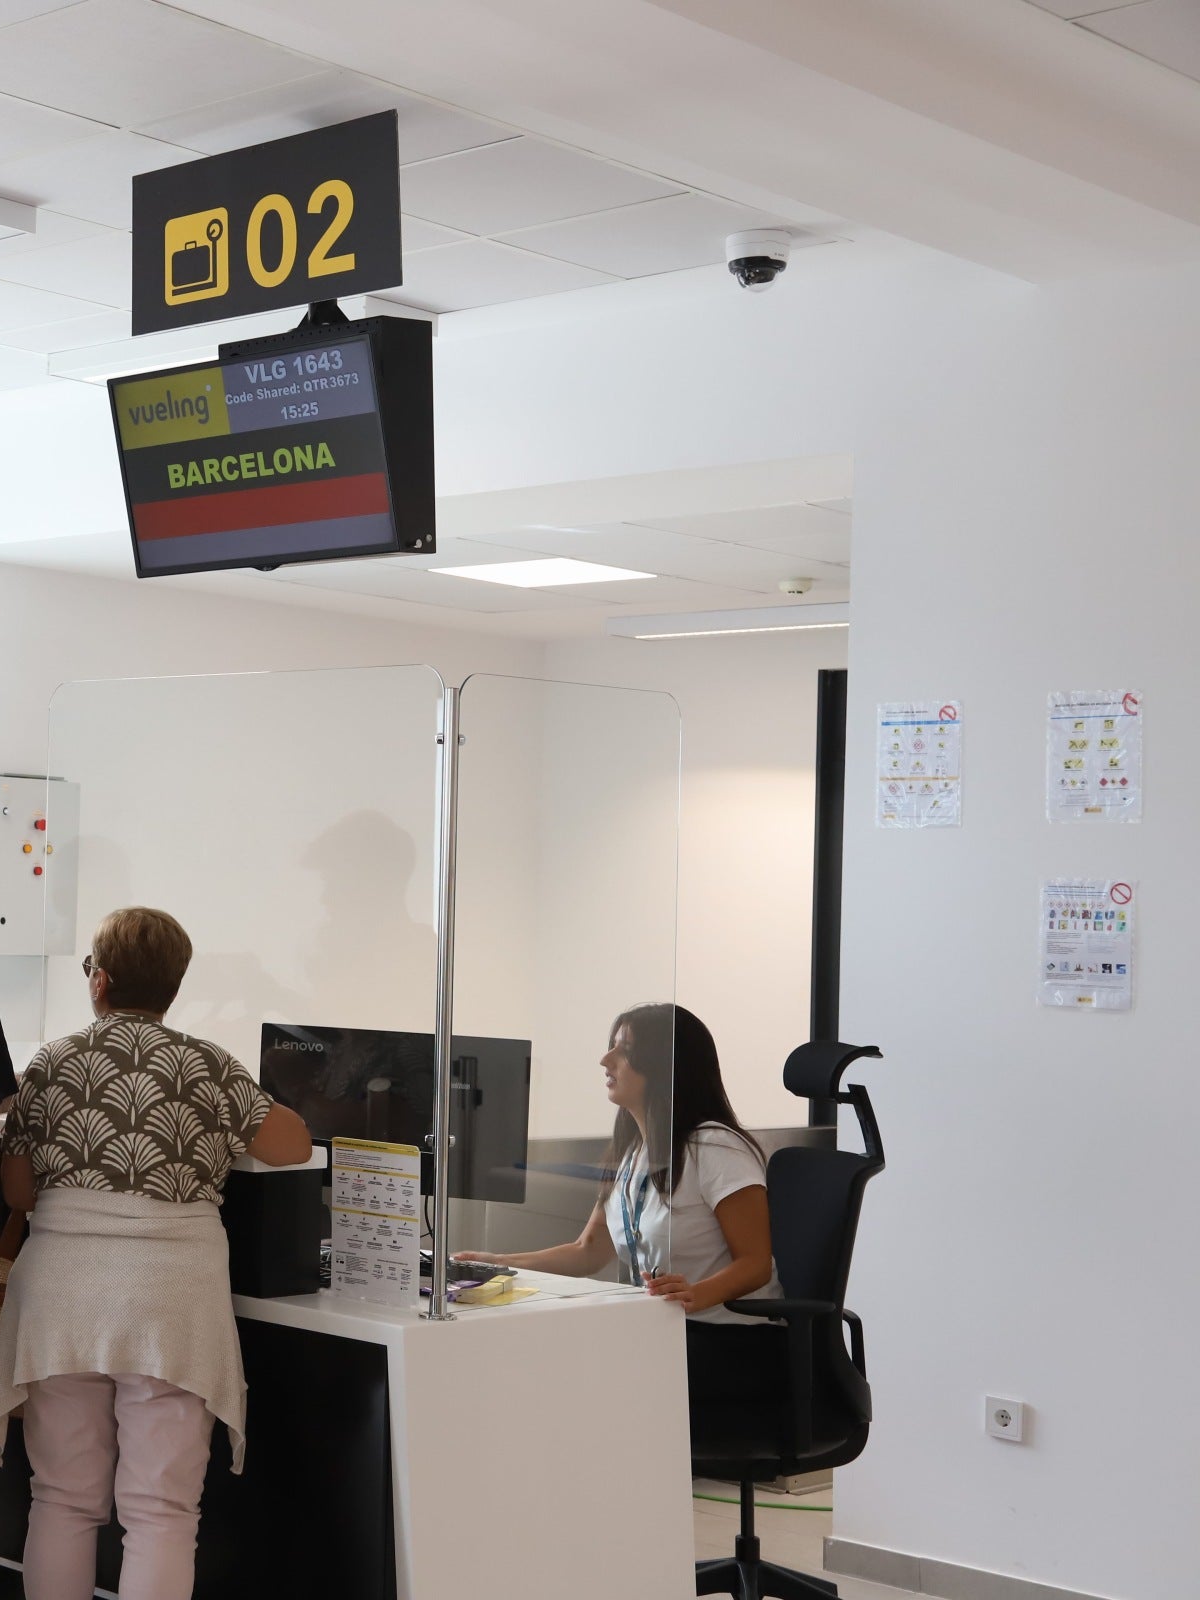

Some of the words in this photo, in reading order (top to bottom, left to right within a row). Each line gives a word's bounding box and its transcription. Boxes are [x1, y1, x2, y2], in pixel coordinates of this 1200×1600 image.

[246, 179, 356, 288] 02
[244, 359, 287, 384] VLG
[293, 350, 343, 376] 1643
[225, 391, 254, 405] Code
[256, 383, 301, 400] Shared:
[303, 372, 360, 392] QTR3673
[128, 389, 211, 425] vueling
[280, 401, 320, 420] 15:25
[167, 442, 337, 489] BARCELONA
[274, 1038, 325, 1053] Lenovo
